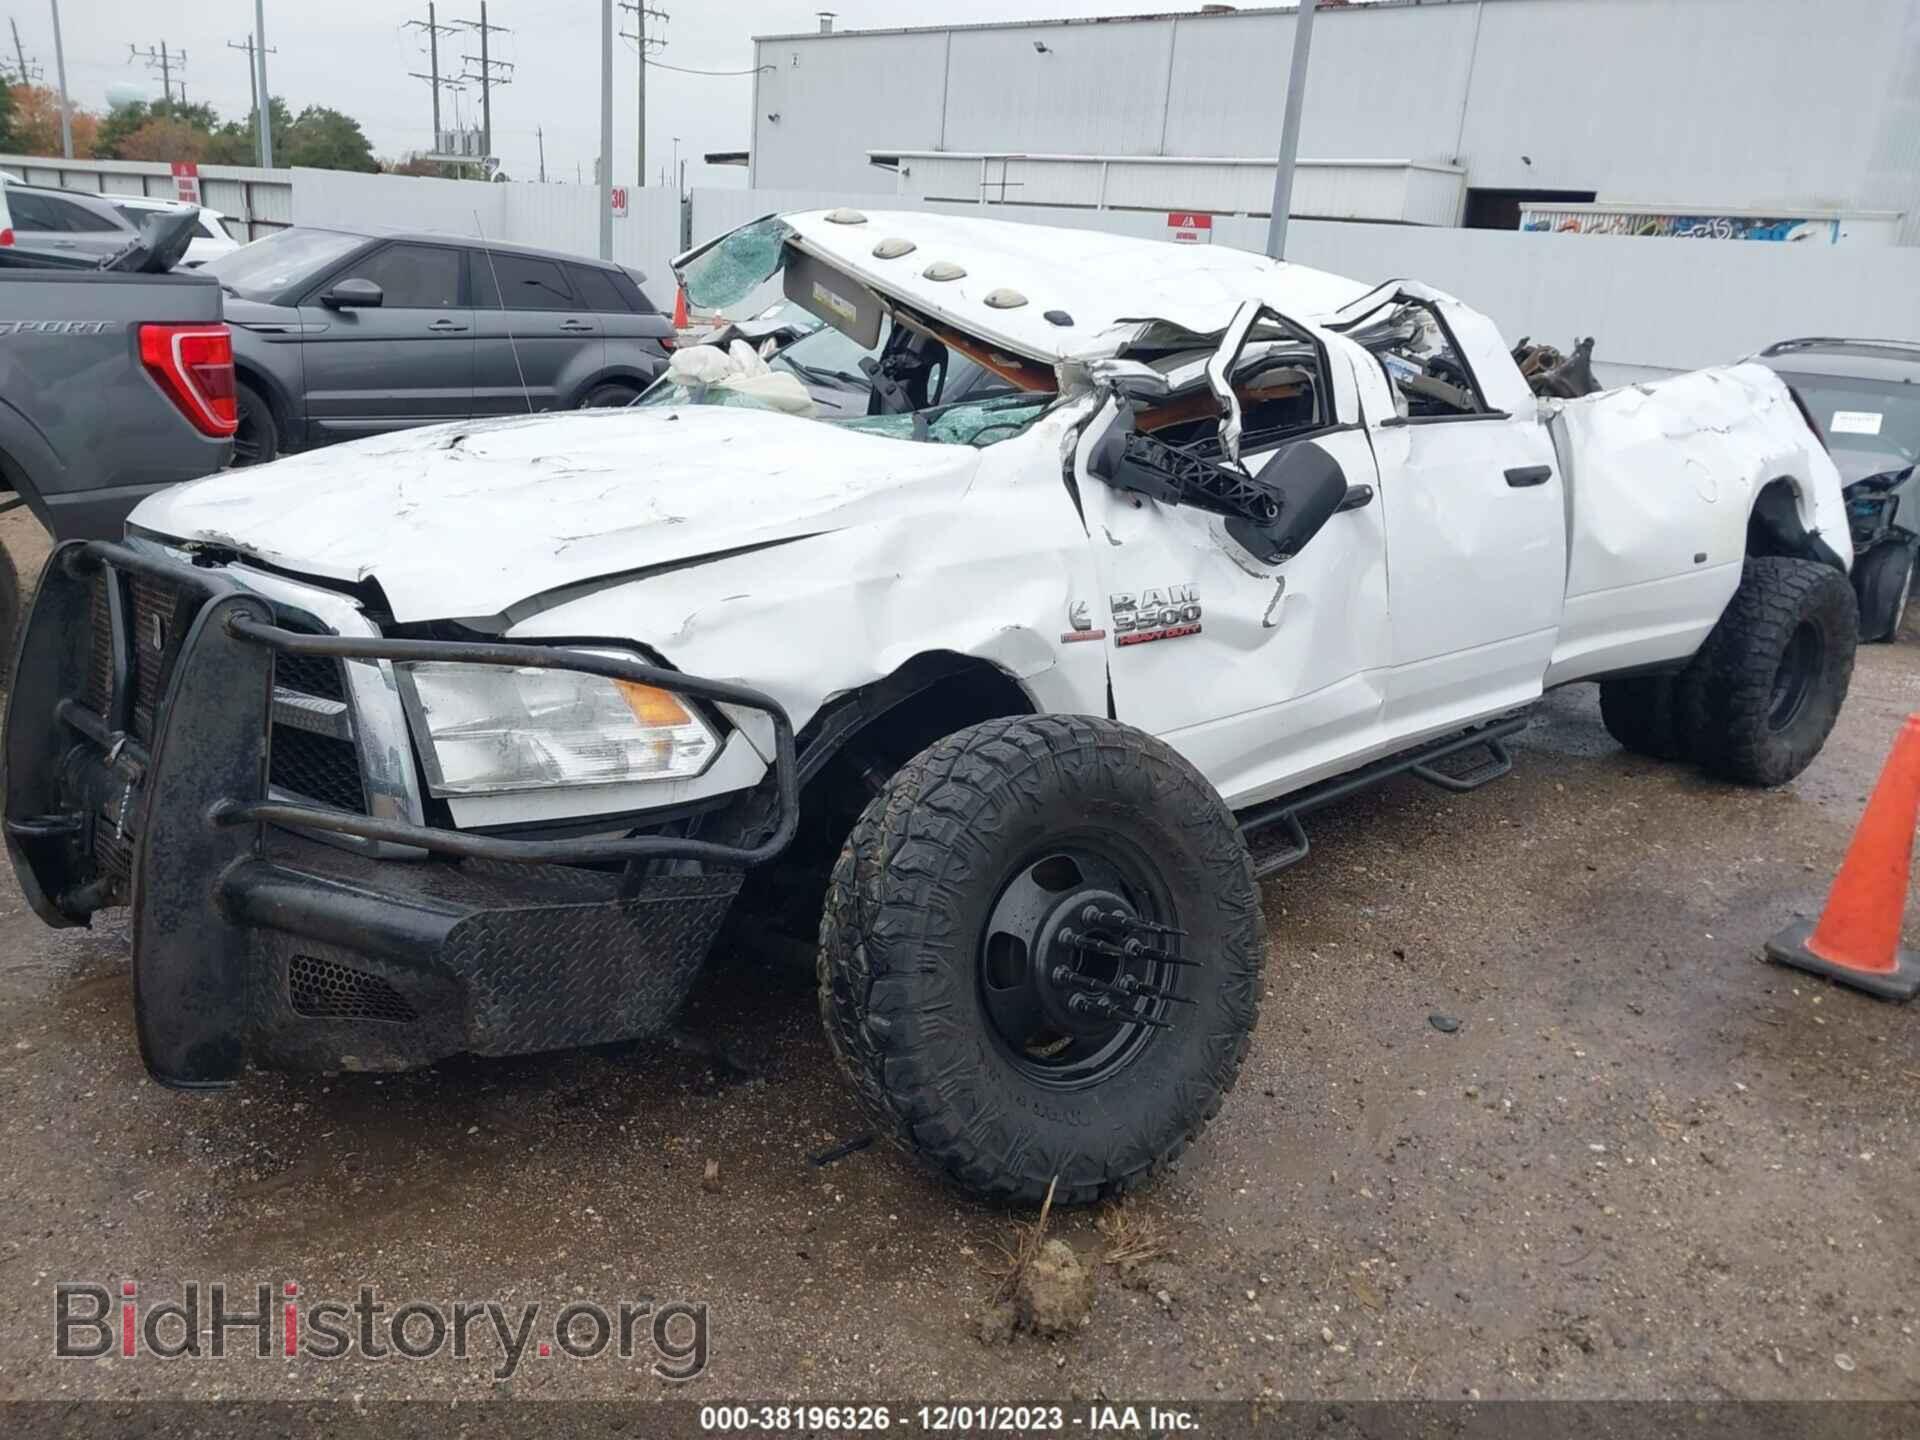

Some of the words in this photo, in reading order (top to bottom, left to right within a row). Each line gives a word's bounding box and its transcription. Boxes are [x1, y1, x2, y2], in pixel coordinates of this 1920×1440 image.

[611, 189, 625, 209] 30
[1110, 583, 1201, 613] RAM
[1113, 604, 1202, 634] 3500
[1119, 630, 1165, 646] HEAVY
[1167, 624, 1200, 639] DUTY
